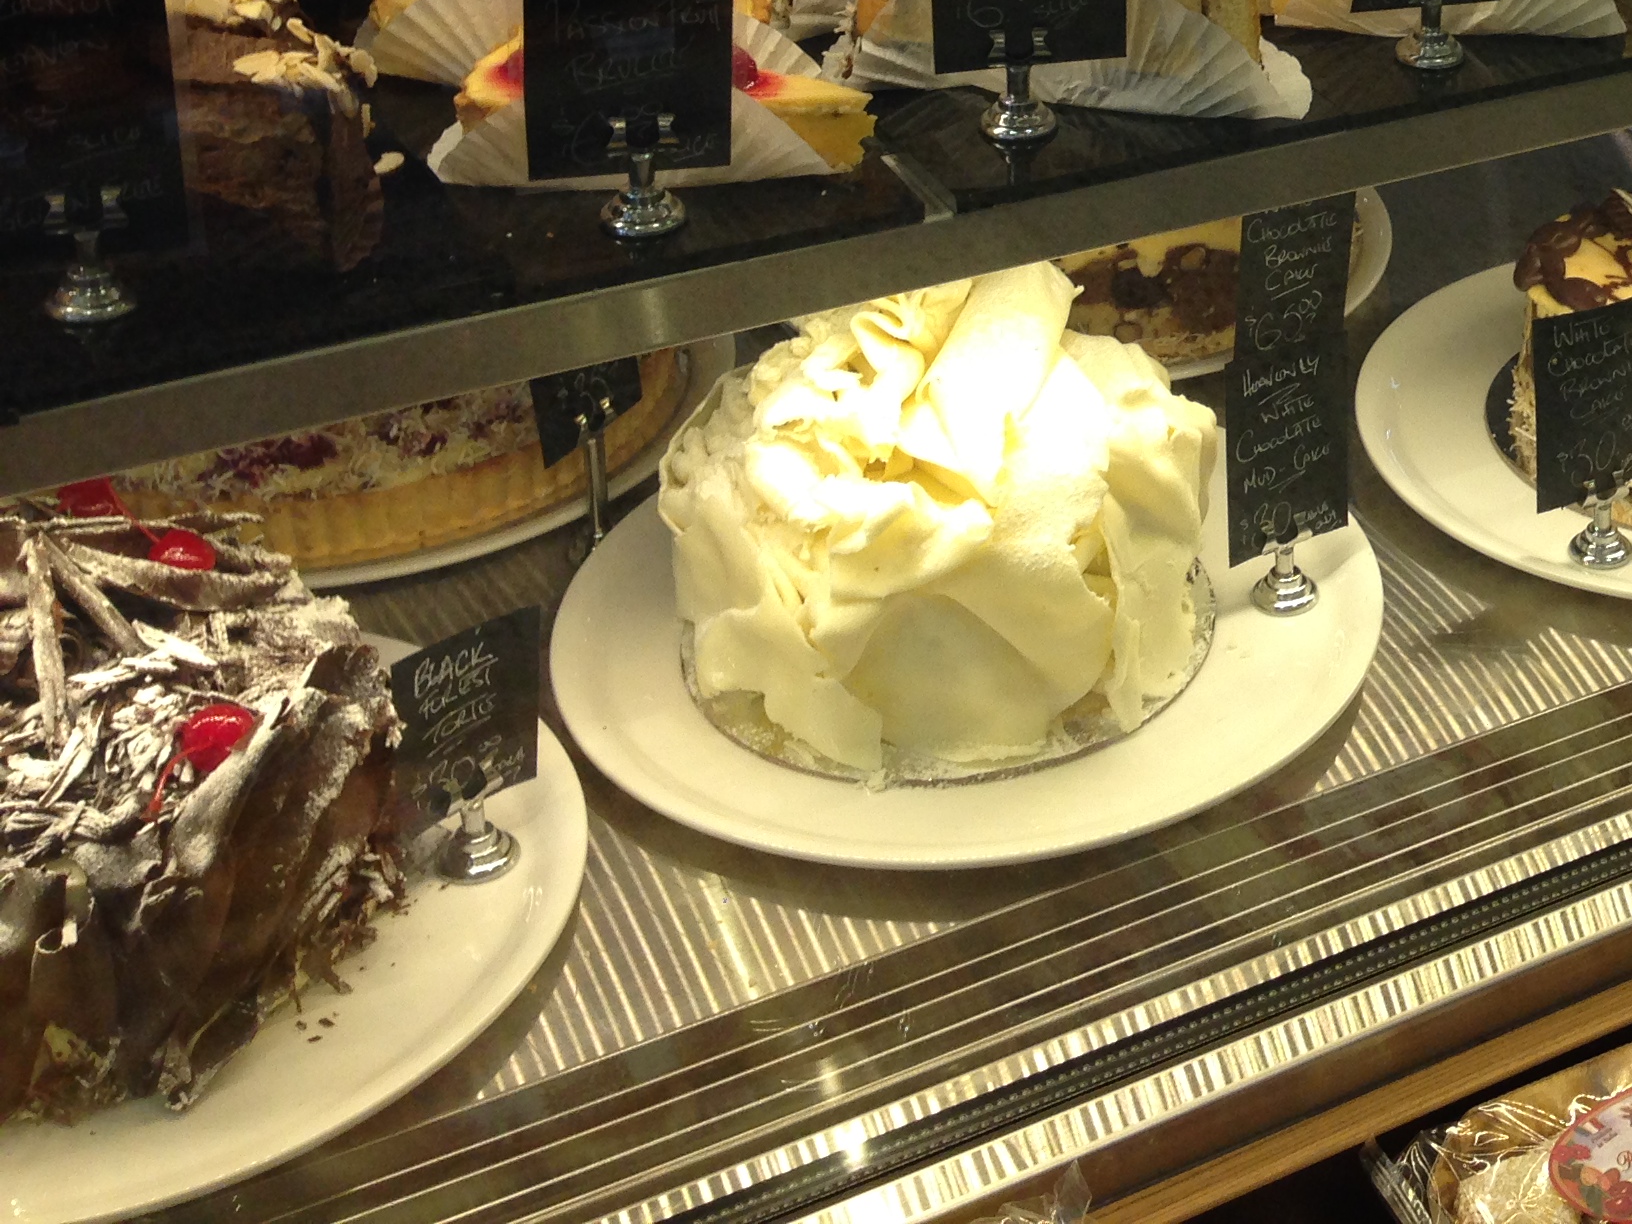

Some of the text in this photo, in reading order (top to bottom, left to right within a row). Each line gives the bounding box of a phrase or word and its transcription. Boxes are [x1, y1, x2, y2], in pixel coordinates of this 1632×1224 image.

[1246, 211, 1338, 245] CHOCOLATE
[1264, 235, 1332, 269] BROWNIE
[1553, 316, 1615, 349] WHITE
[1236, 414, 1323, 463] CHOCOLATE
[414, 641, 495, 698] BLACK
